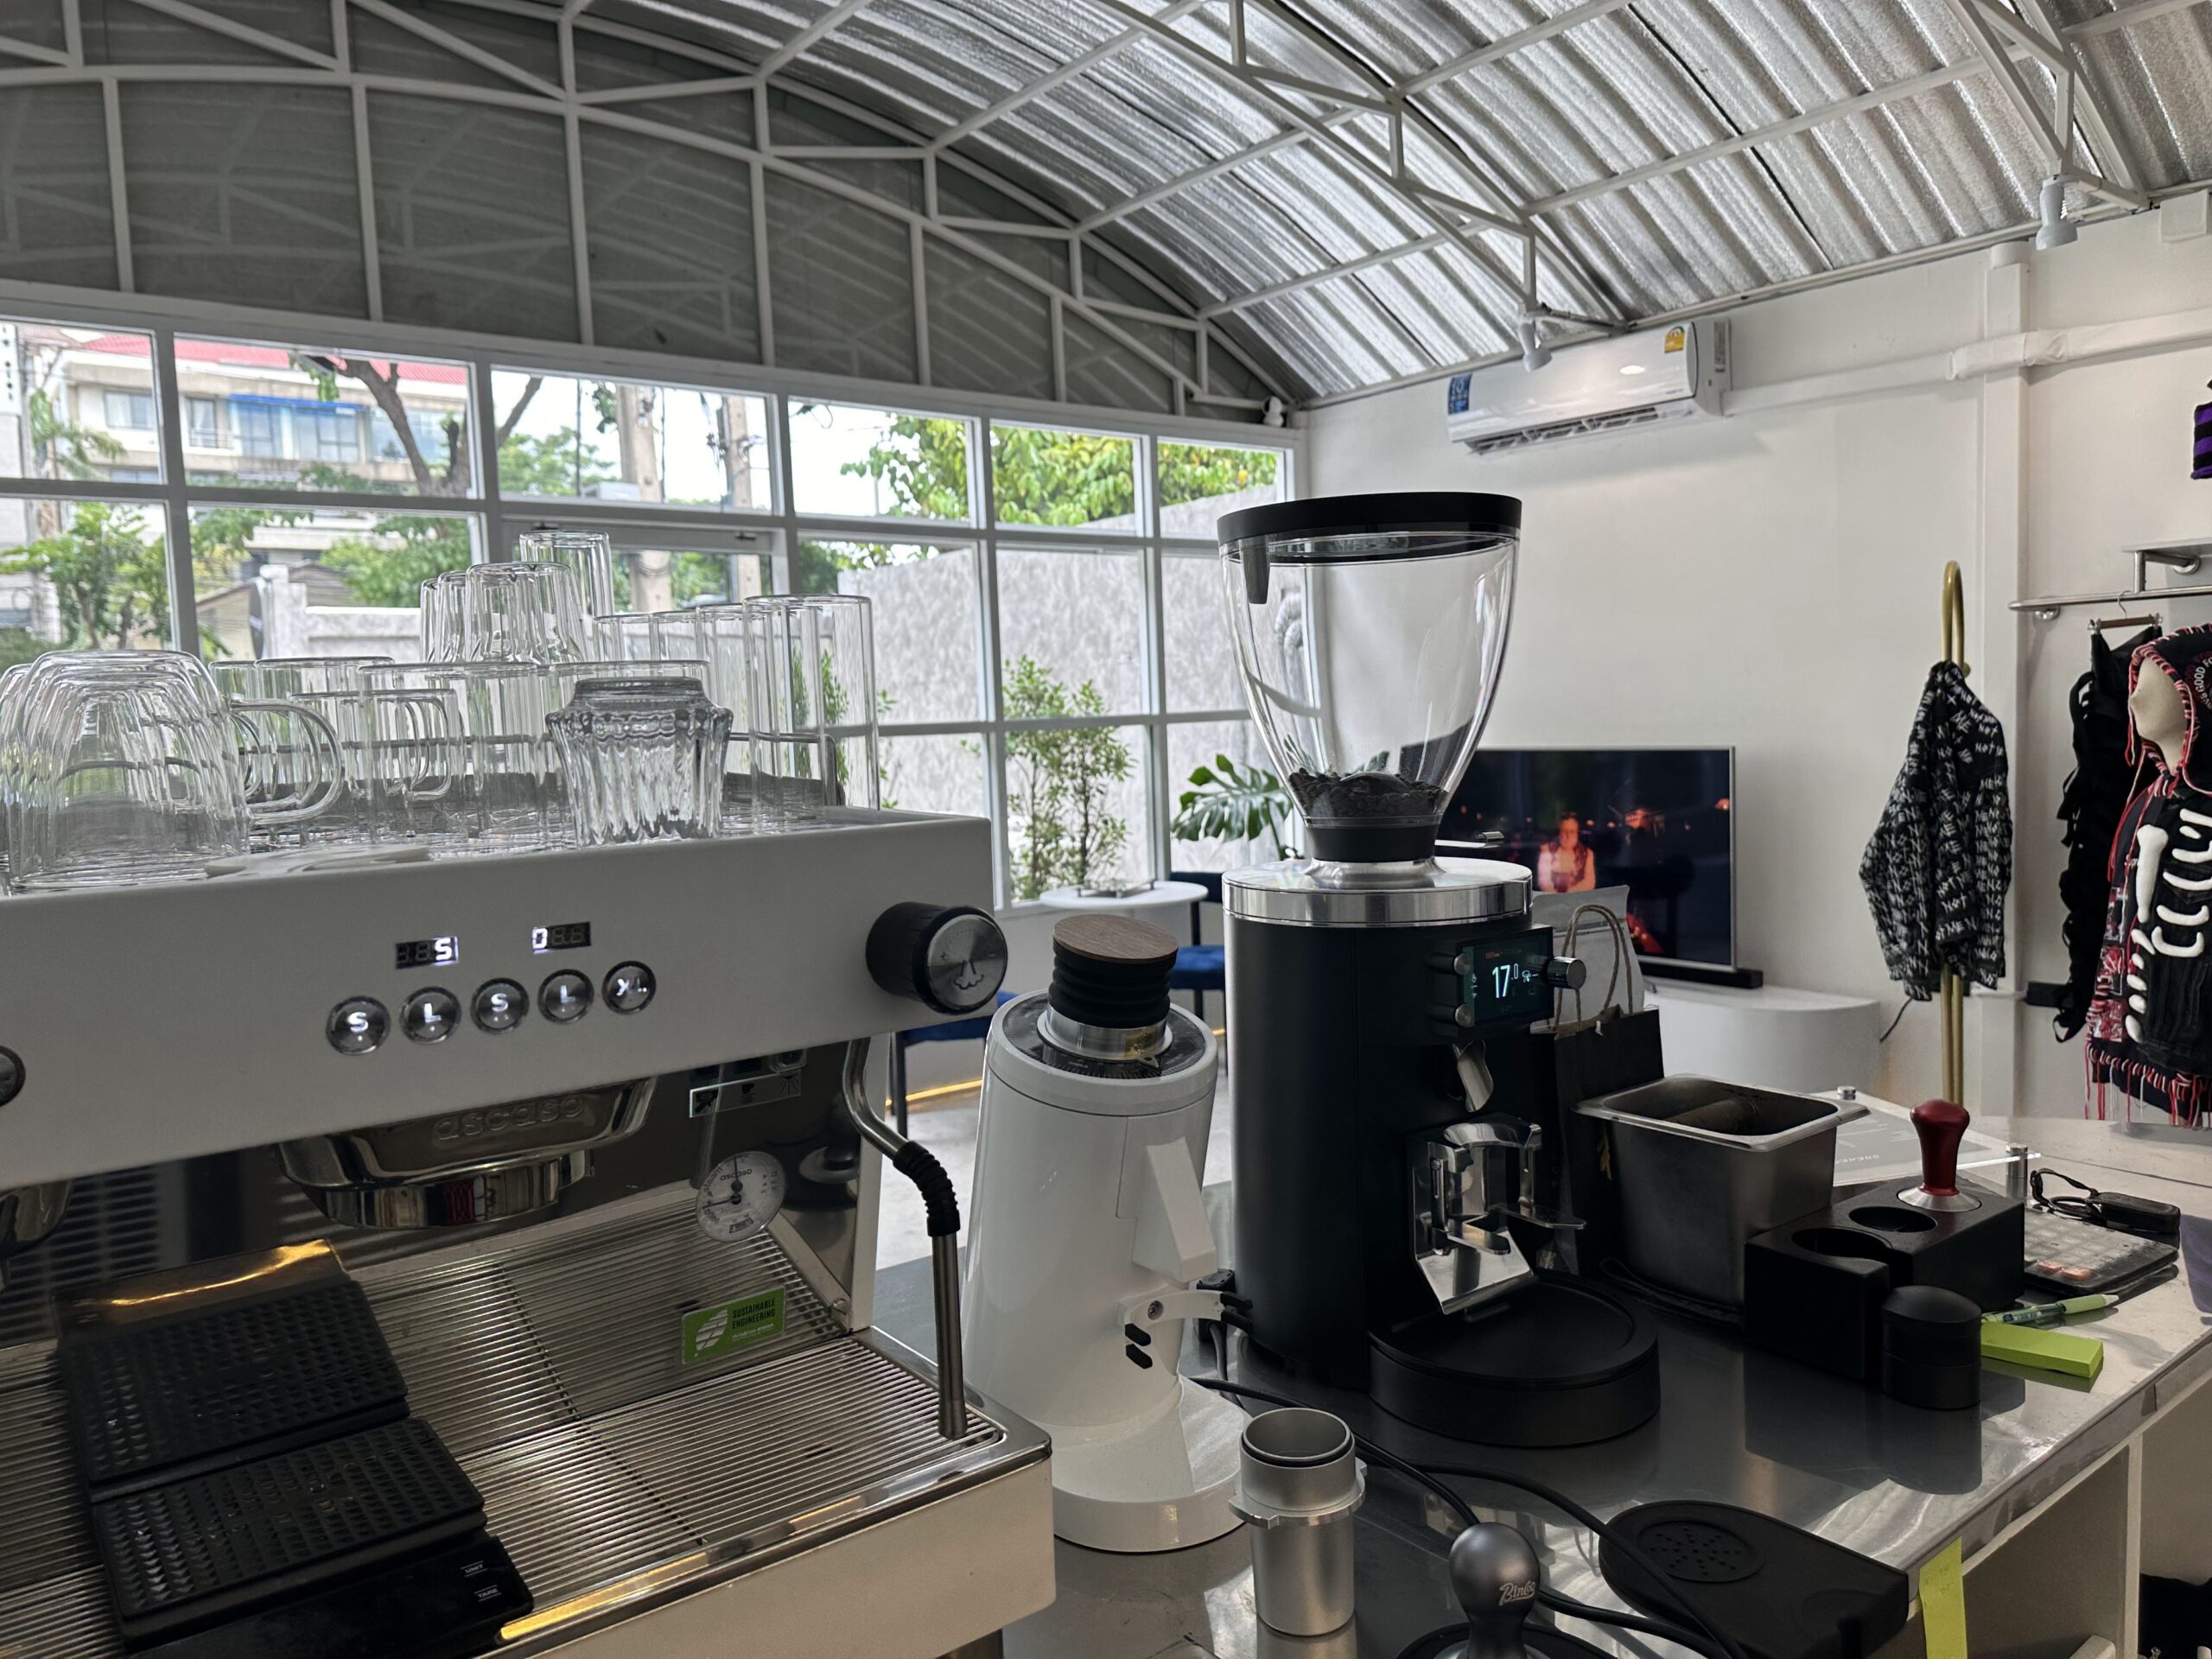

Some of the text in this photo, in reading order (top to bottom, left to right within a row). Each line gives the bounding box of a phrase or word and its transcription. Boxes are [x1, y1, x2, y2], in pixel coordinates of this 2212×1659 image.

[2194, 666, 2206, 692] GOOD
[491, 993, 509, 1012] S
[559, 984, 575, 1003] L
[347, 1011, 369, 1033] S
[423, 1002, 442, 1023] L
[437, 1094, 585, 1141] ascaso
[720, 1168, 753, 1181] ascaso
[732, 1308, 776, 1329] ENGINEERING
[733, 1298, 776, 1319] SUSTAINABLE
[464, 1563, 484, 1573] UNIT
